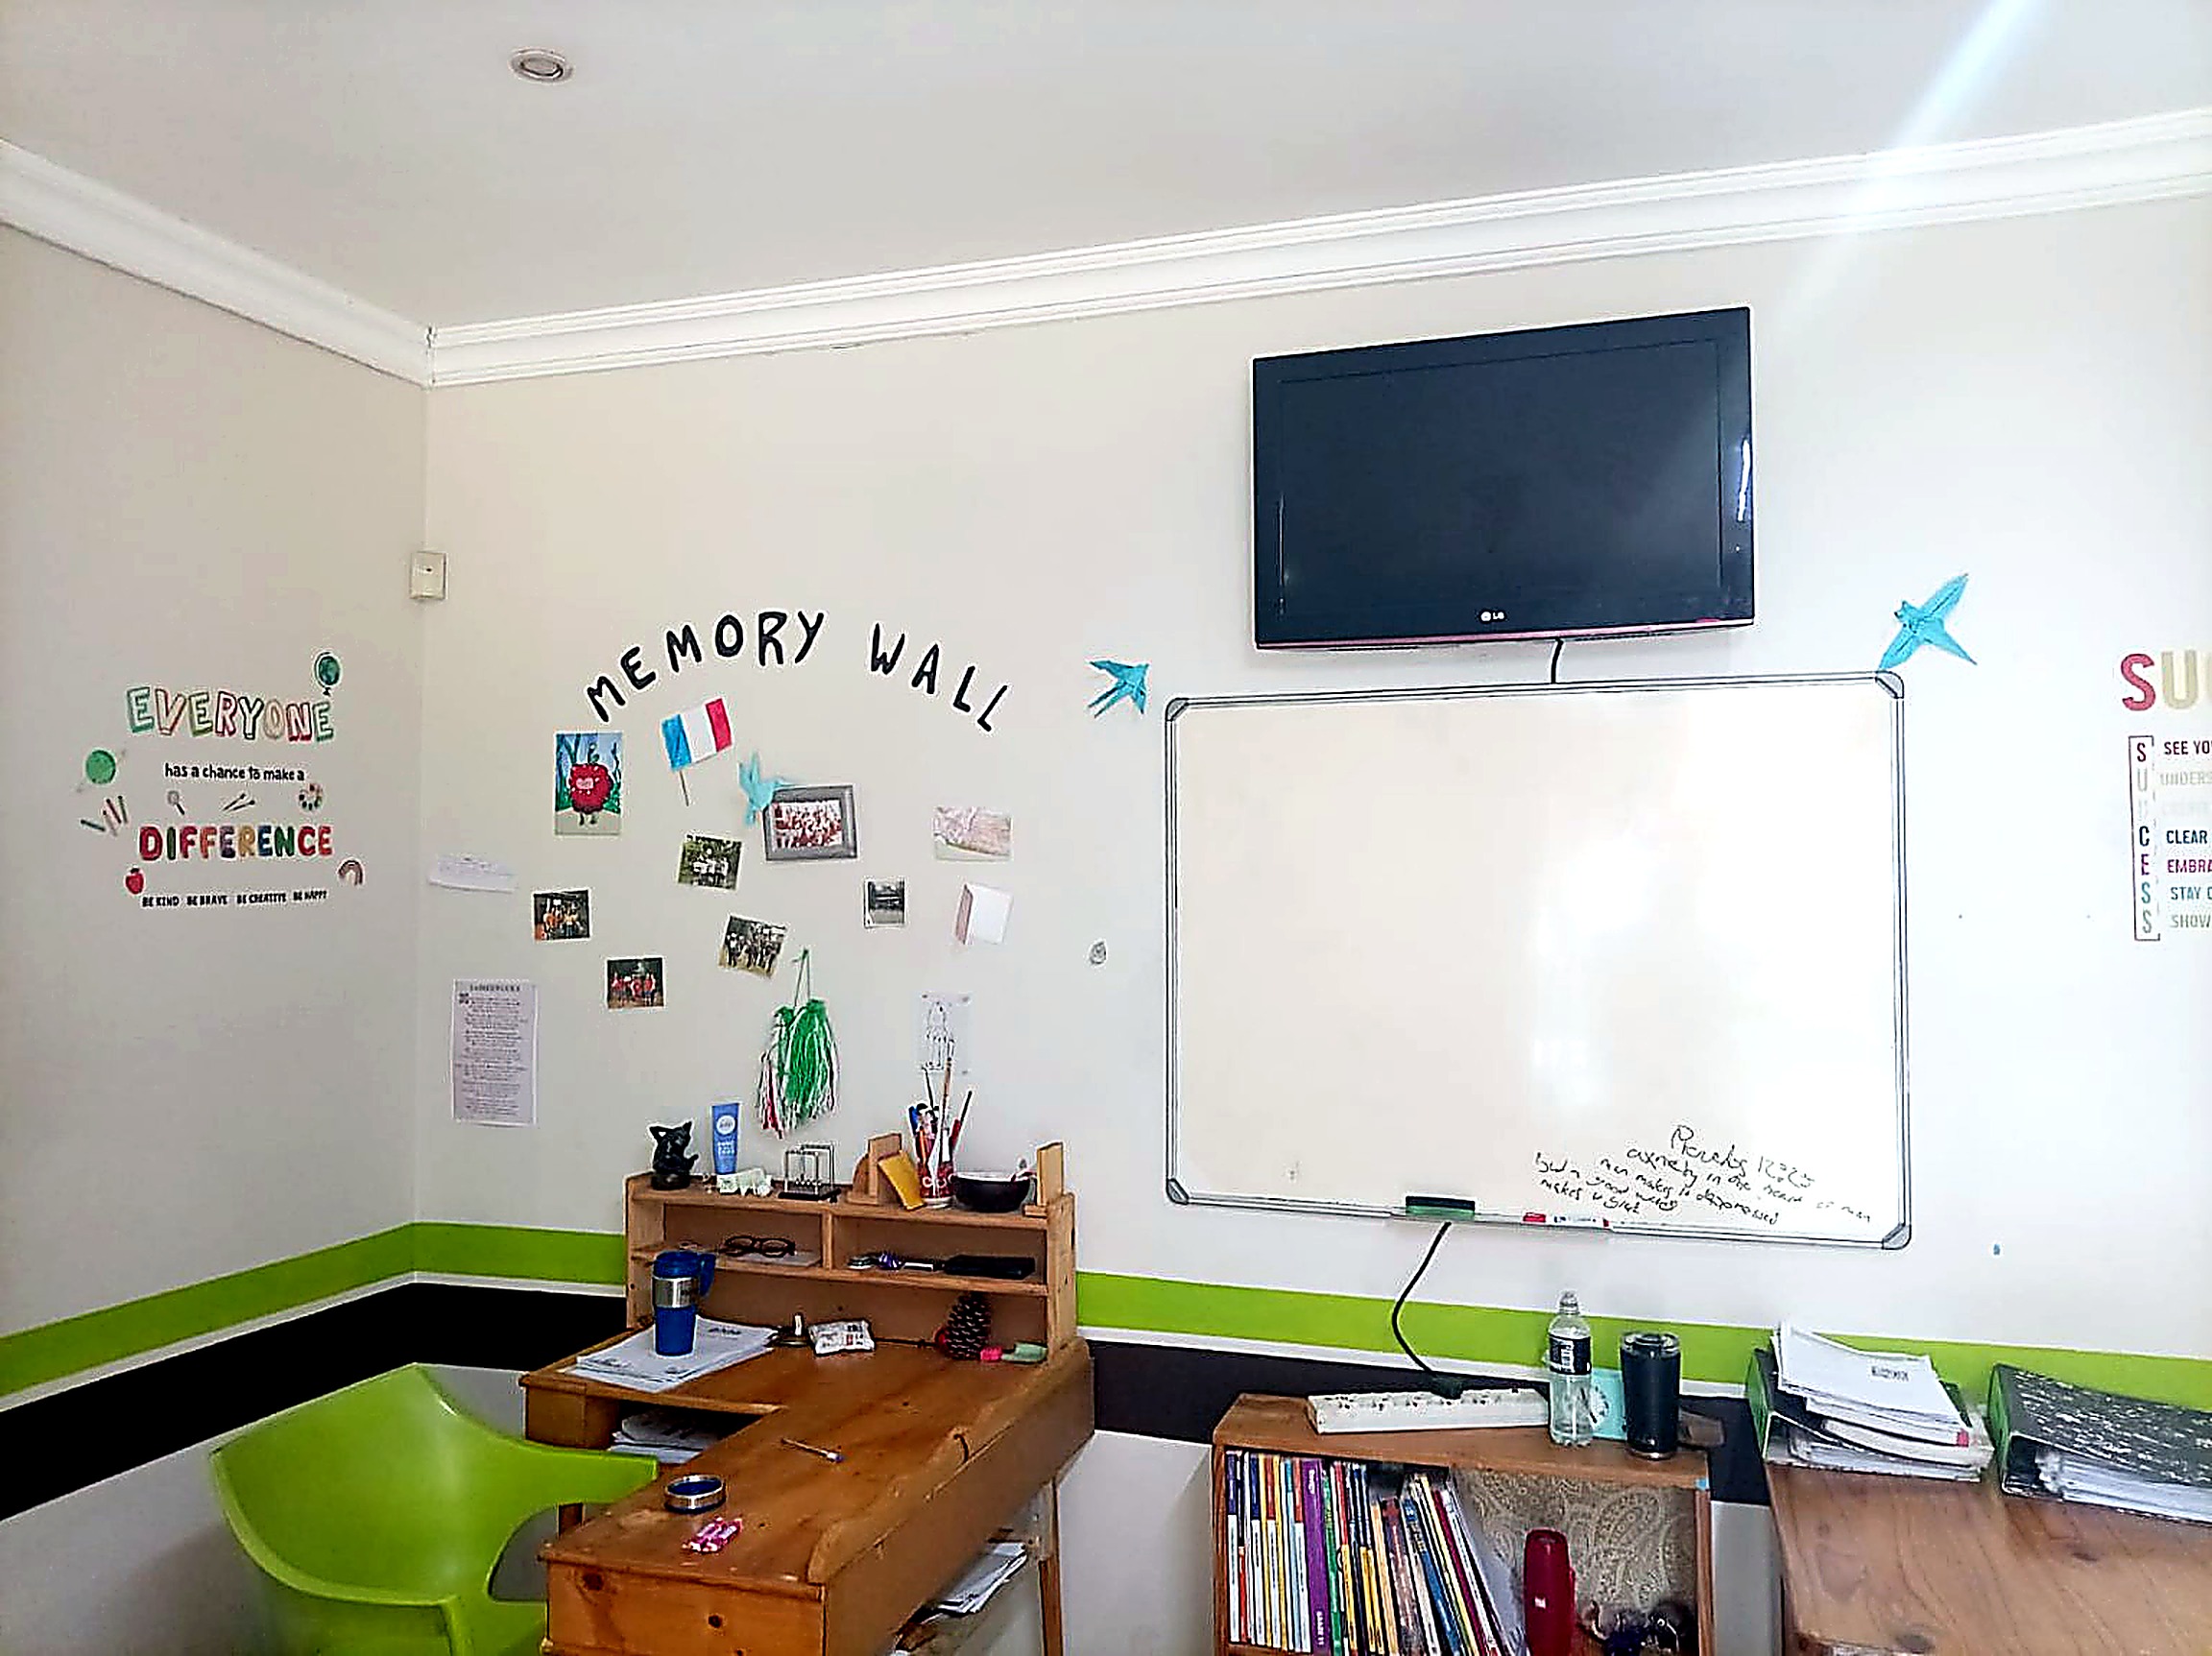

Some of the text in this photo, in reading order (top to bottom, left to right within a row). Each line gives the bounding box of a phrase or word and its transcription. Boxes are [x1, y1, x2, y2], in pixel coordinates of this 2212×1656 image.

[587, 611, 1008, 732] MEMORY WALL
[127, 686, 334, 742] EVERYONE
[2164, 740, 2212, 756] SEE YO
[165, 762, 304, 780] has a chance to make a
[138, 826, 333, 861] DIFFERENCE
[2166, 829, 2208, 844] CLEAR
[2170, 886, 2200, 900] STAY
